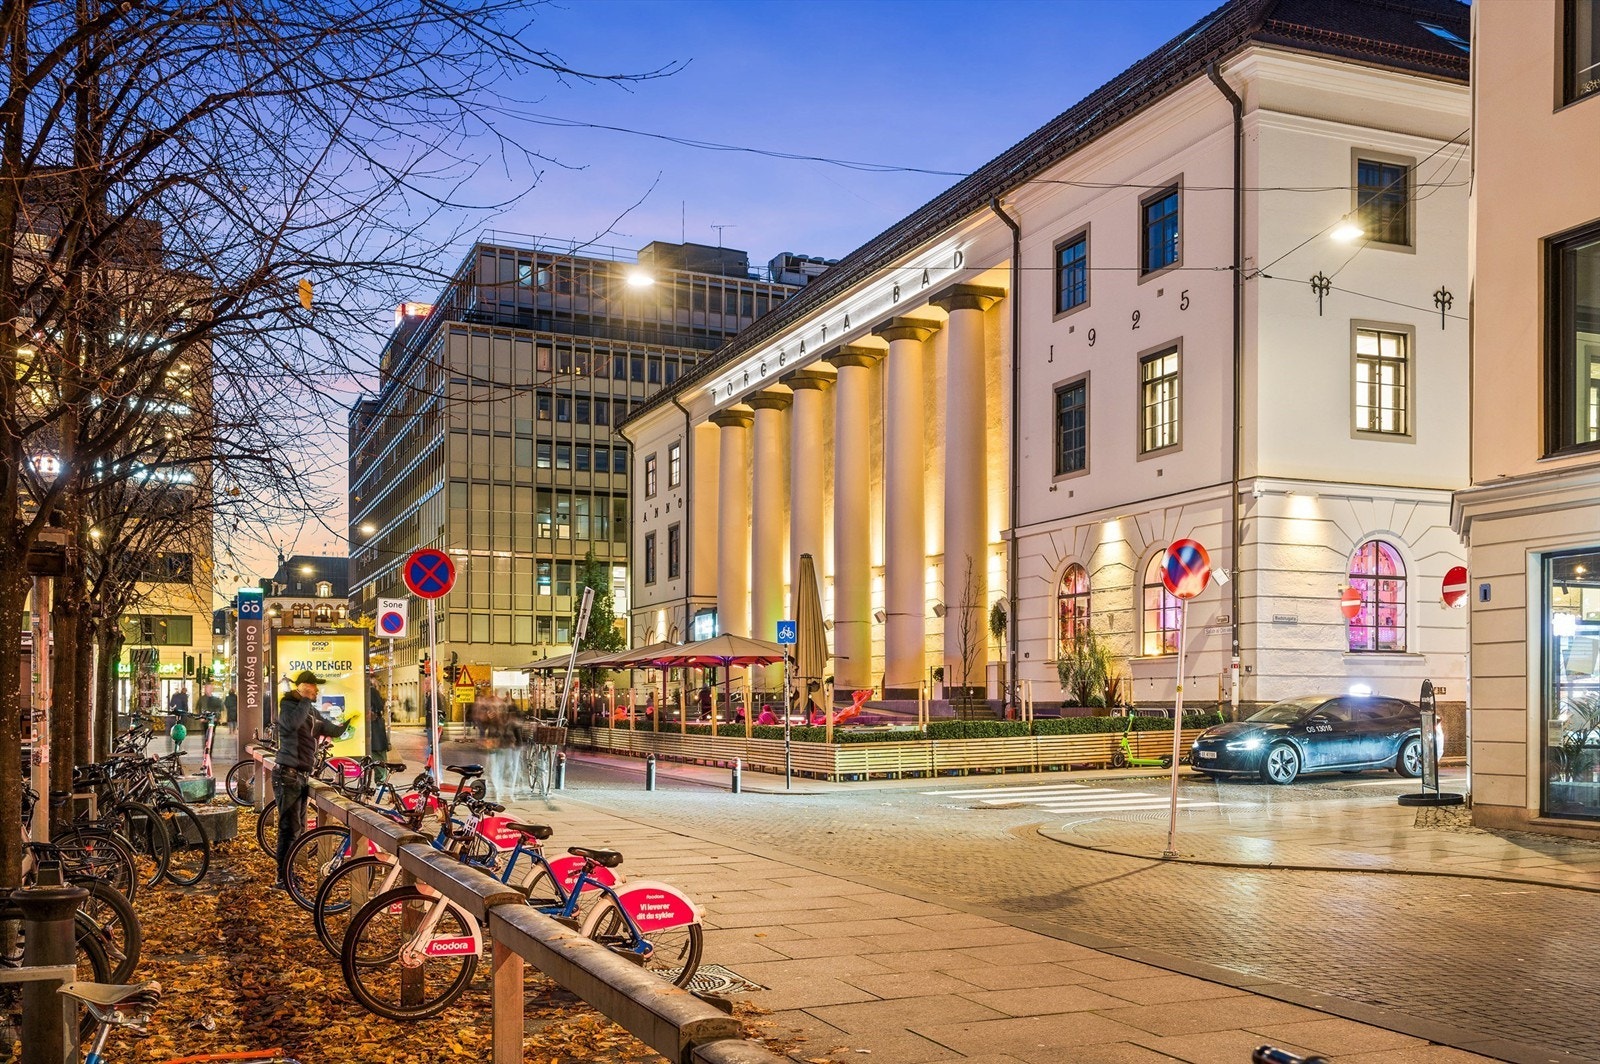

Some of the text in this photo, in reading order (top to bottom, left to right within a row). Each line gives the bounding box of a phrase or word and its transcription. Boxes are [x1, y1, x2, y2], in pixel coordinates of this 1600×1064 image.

[710, 250, 964, 403] TORGGATA BAD
[643, 497, 682, 522] ANNO
[383, 600, 403, 609] Sone
[244, 625, 258, 708] Oslo Bysykkel
[289, 660, 353, 671] SPAR PENGER
[655, 911, 675, 920] sykler
[432, 942, 468, 951] foodora
